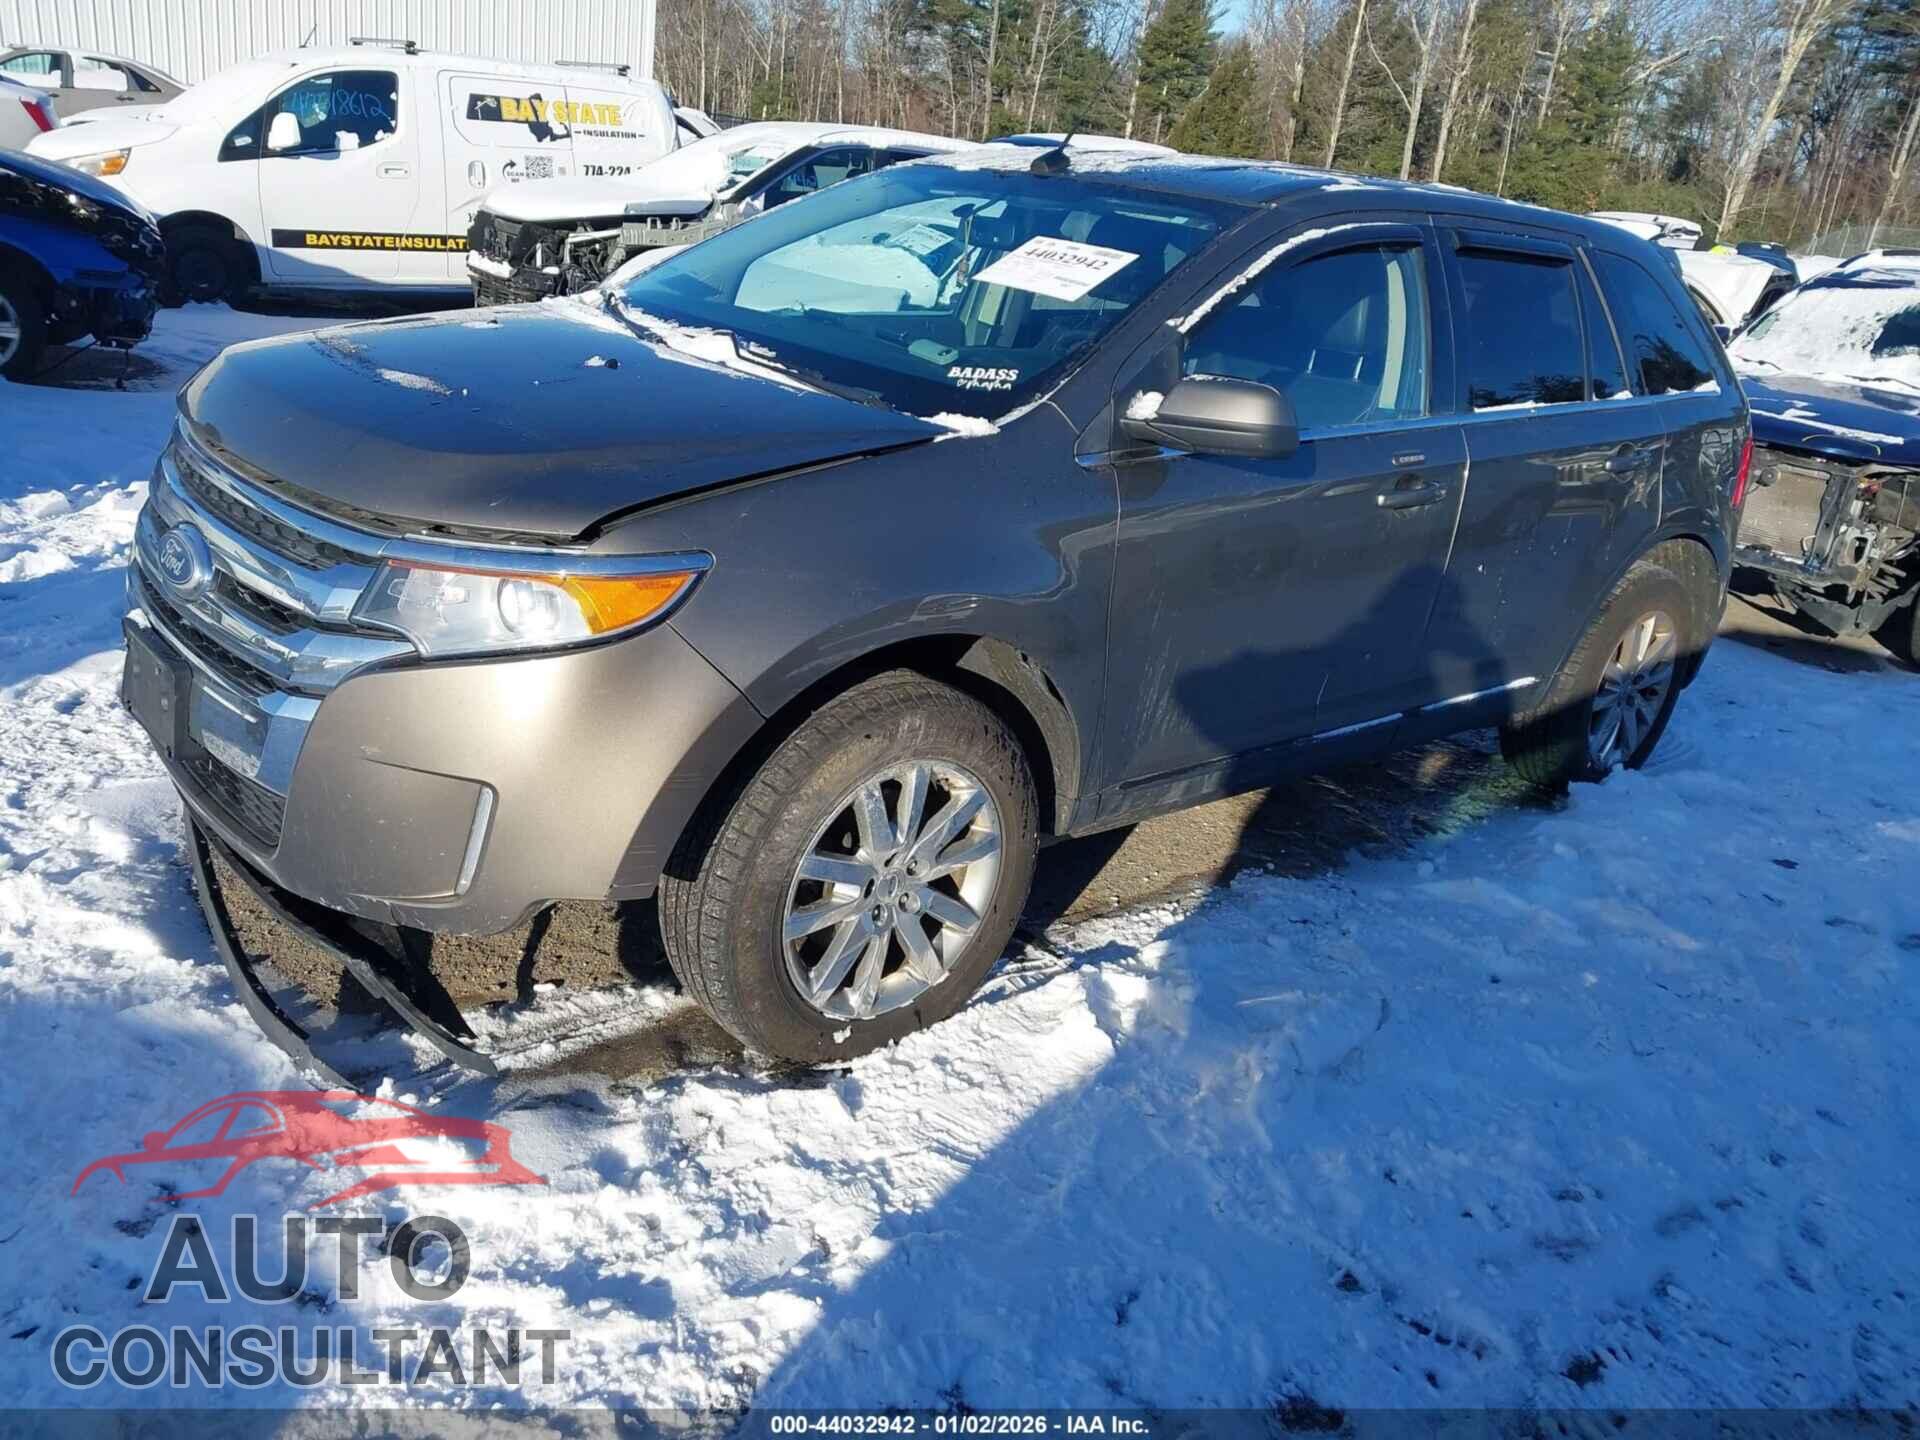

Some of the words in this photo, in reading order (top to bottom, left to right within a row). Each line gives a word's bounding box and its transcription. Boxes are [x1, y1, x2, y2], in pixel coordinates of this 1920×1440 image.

[501, 97, 549, 121] BAY
[553, 101, 623, 126] STATE
[583, 129, 637, 139] INSULATION
[1023, 248, 1108, 270] 44032942
[947, 366, 1019, 381] BADASS
[161, 539, 186, 576] Ford
